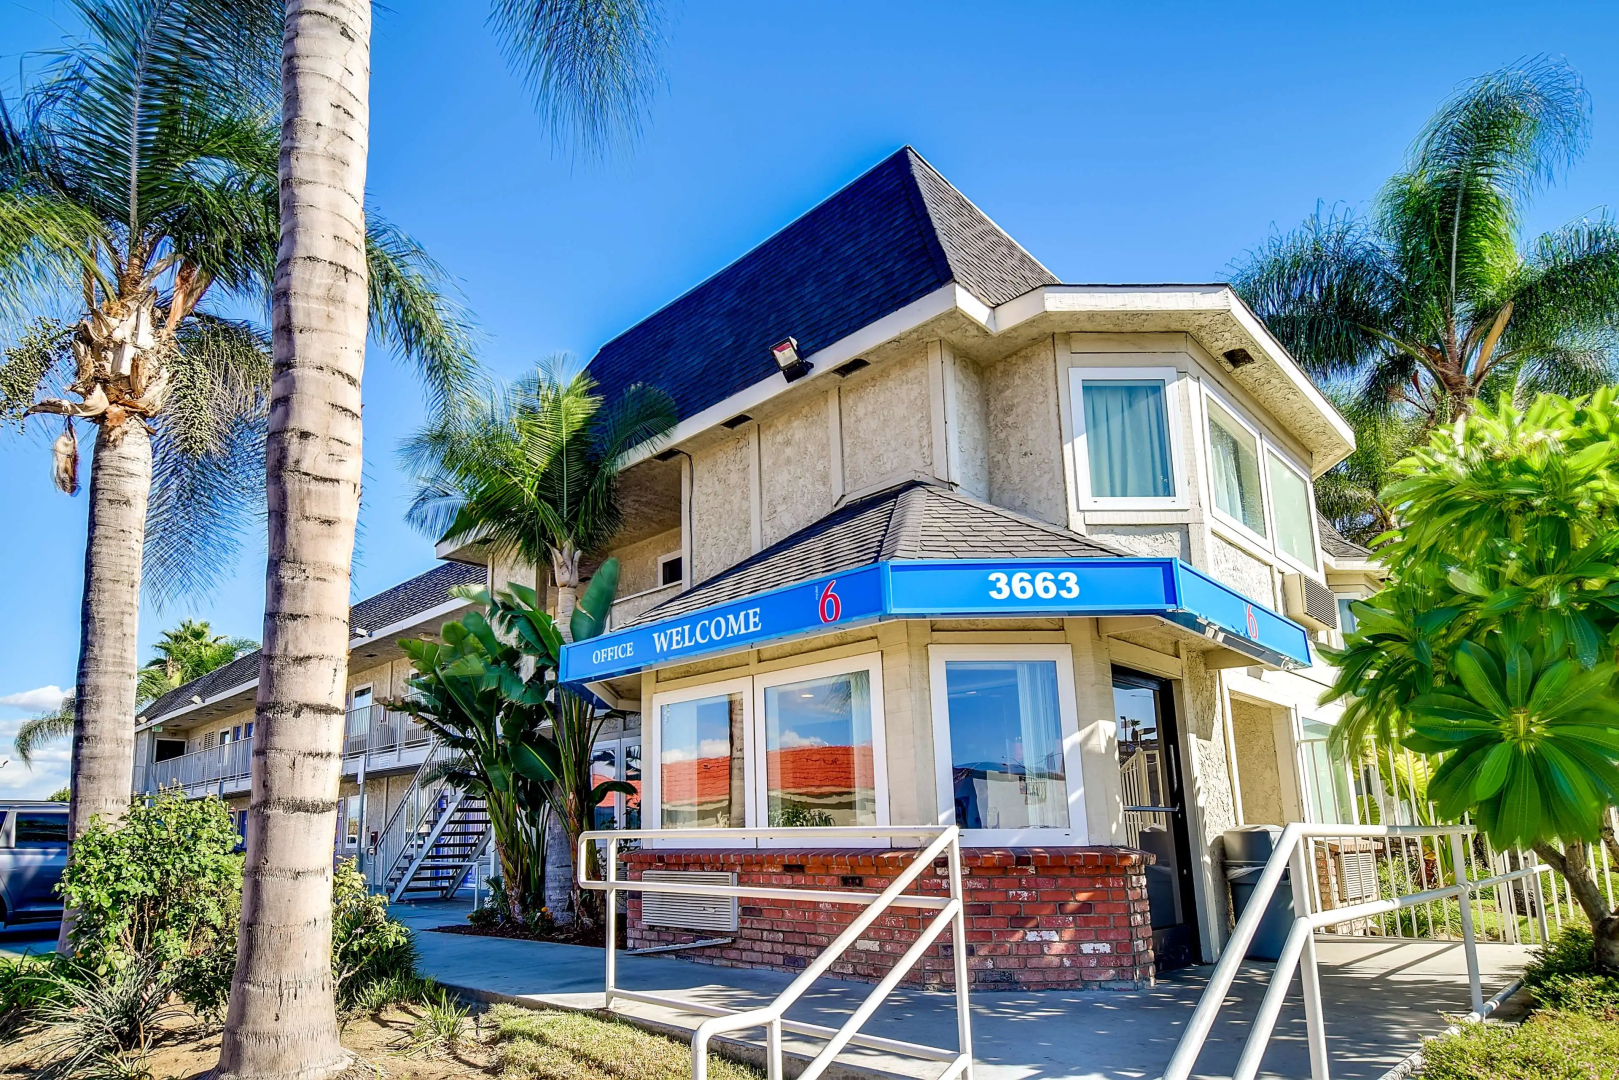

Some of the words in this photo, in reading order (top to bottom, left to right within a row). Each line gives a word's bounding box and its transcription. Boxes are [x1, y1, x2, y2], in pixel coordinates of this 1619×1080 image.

[819, 580, 841, 623] 6
[988, 572, 1080, 600] 3663
[592, 642, 634, 664] OFFICE
[652, 607, 762, 653] WELCOME
[1247, 603, 1258, 640] 6
